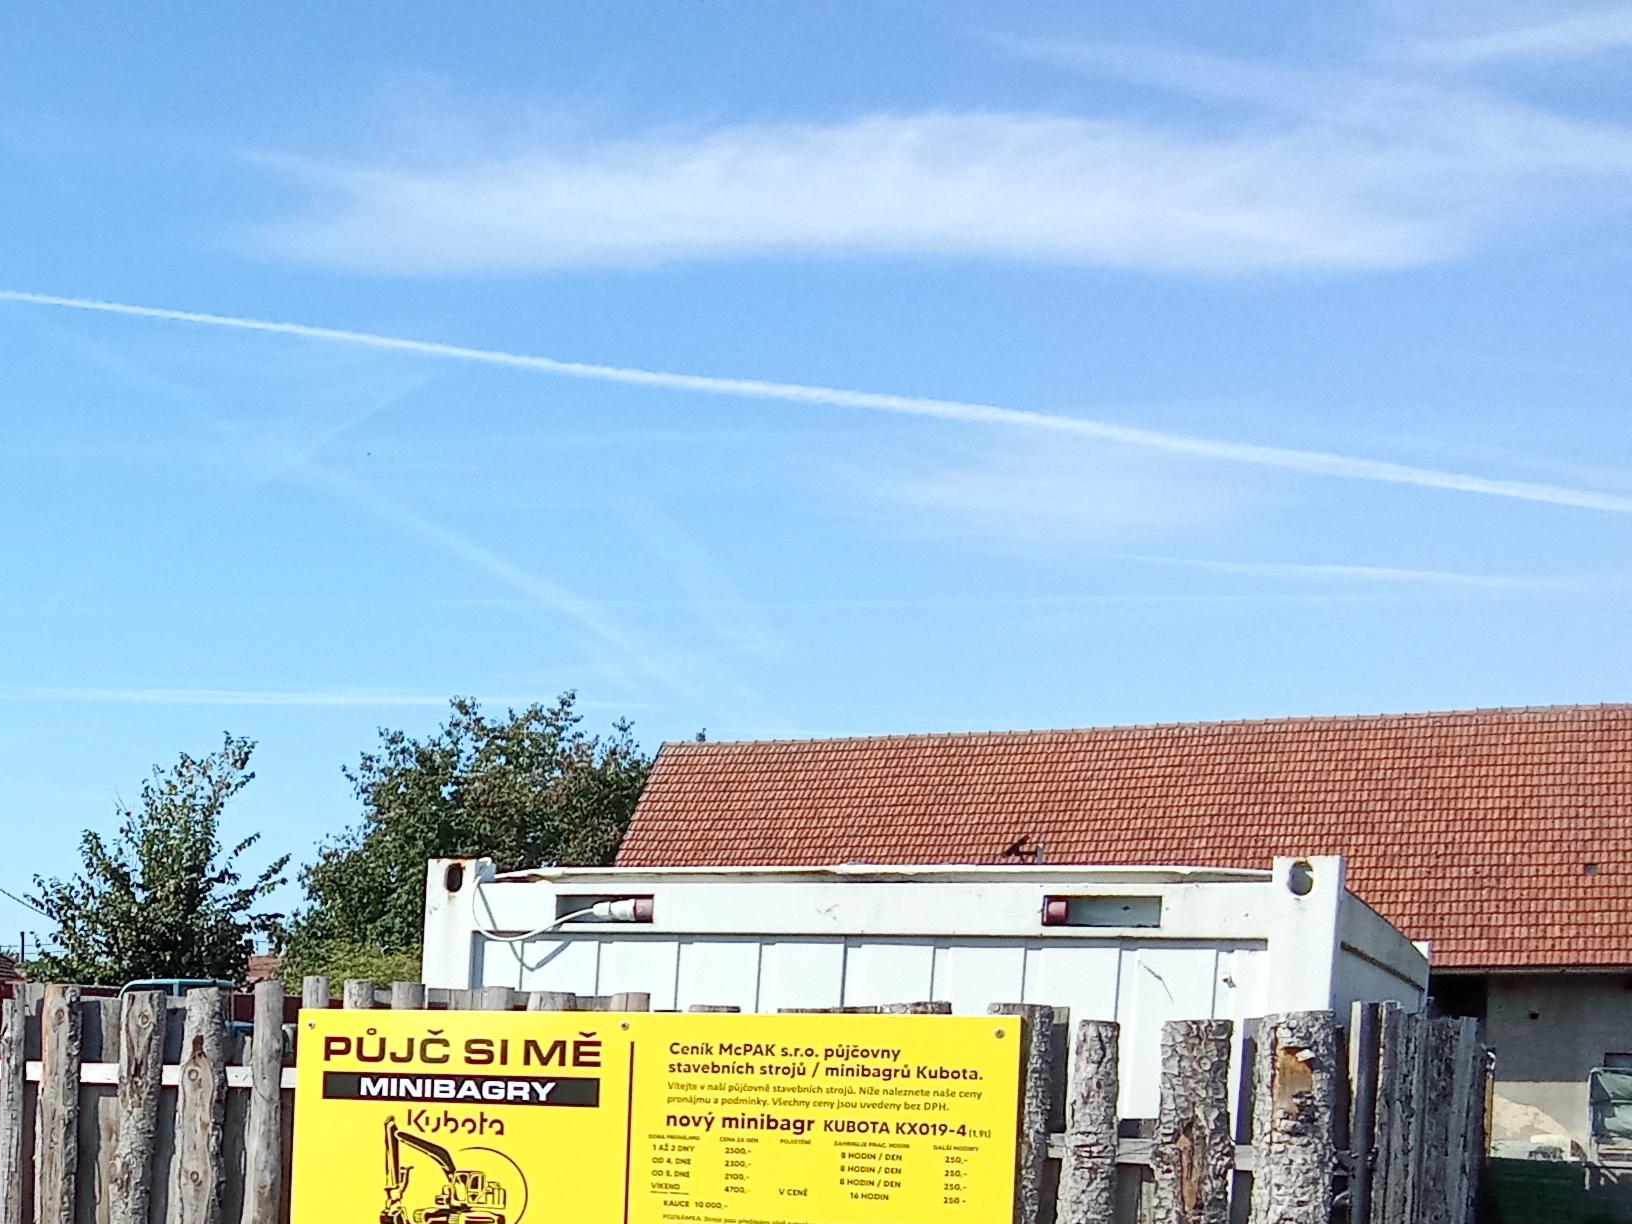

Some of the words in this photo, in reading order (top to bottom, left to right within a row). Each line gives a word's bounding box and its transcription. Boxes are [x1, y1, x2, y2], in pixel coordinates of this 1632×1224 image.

[323, 1028, 450, 1064] PŮJČ
[464, 1038, 509, 1065] SI
[523, 1032, 602, 1067] MĚ
[669, 1042, 714, 1055] Ceník
[718, 1043, 776, 1056] McPAK
[780, 1047, 819, 1058] s.r.o.
[824, 1044, 901, 1062] půjčovny
[668, 1061, 755, 1074] stavebních
[759, 1062, 806, 1079] strojů
[811, 1061, 820, 1078] /
[825, 1064, 911, 1081] minibagrů
[916, 1066, 983, 1080] Kubota.
[359, 1077, 556, 1102] MINIBAGRY
[707, 1082, 727, 1091] naší
[772, 1084, 823, 1094] stavebních
[882, 1087, 931, 1097] naleznete
[932, 1088, 957, 1098] naše
[958, 1091, 983, 1100] ceny
[667, 1095, 711, 1105] pronájmu
[720, 1096, 770, 1107] podmínky.
[771, 1097, 811, 1109] Všechny
[812, 1100, 835, 1110] ceny
[836, 1099, 858, 1110] jsou
[859, 1100, 902, 1111] uvedeny
[903, 1101, 921, 1111] bez
[923, 1102, 950, 1111] DPH.
[407, 1109, 505, 1136] Kubota
[666, 1112, 715, 1132] nový
[721, 1113, 815, 1135] minibagr
[823, 1120, 890, 1134] KUBOTA
[895, 1122, 967, 1137] KX019-4
[848, 1152, 876, 1160] HODIN
[884, 1153, 902, 1161] DEN
[847, 1165, 876, 1173] HODIN
[884, 1167, 902, 1175] DEN
[883, 1180, 901, 1188] DEN
[860, 1192, 889, 1201] HODIN
